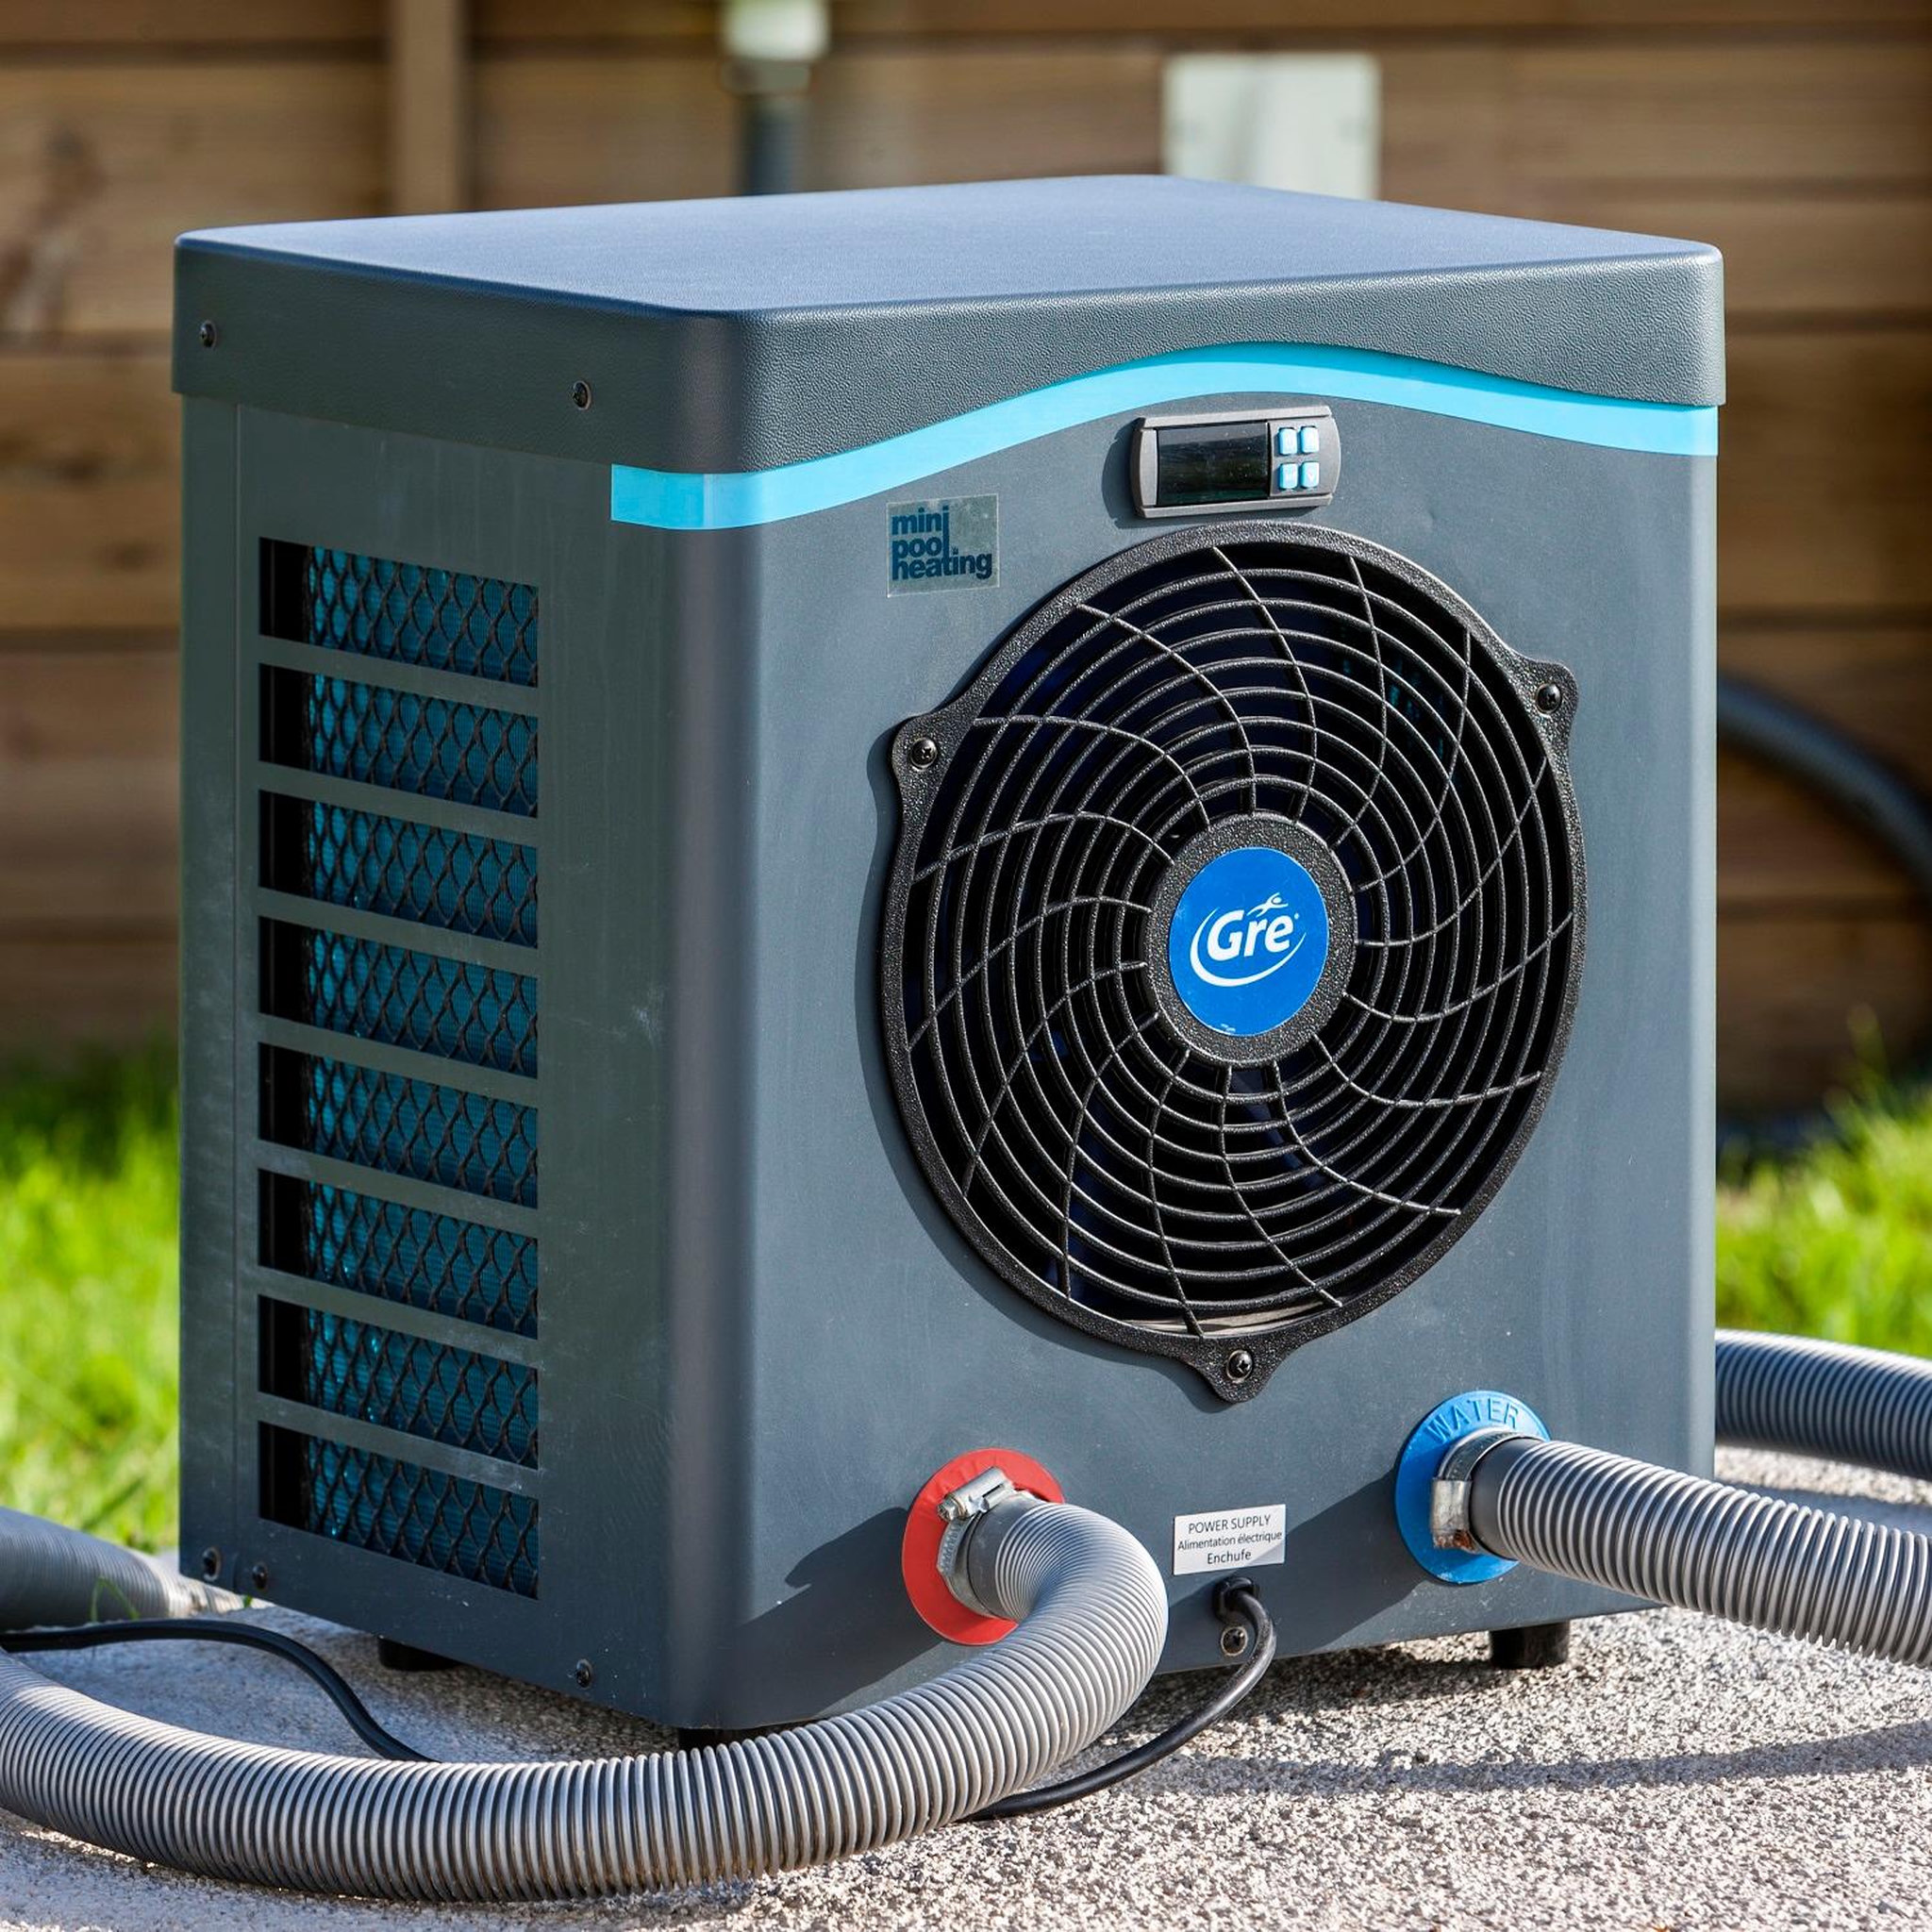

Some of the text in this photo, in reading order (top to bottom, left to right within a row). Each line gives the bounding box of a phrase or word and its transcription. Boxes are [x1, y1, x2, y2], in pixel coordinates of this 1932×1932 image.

[891, 505, 949, 535] mini
[891, 529, 950, 560] pool
[891, 547, 992, 580] heating
[1207, 909, 1294, 961] Gre
[1427, 1397, 1519, 1444] WATER
[1188, 1514, 1272, 1534] POWER SUPPLY
[1177, 1531, 1283, 1551] Alimentation électrique
[1208, 1549, 1252, 1564] Enchufe
